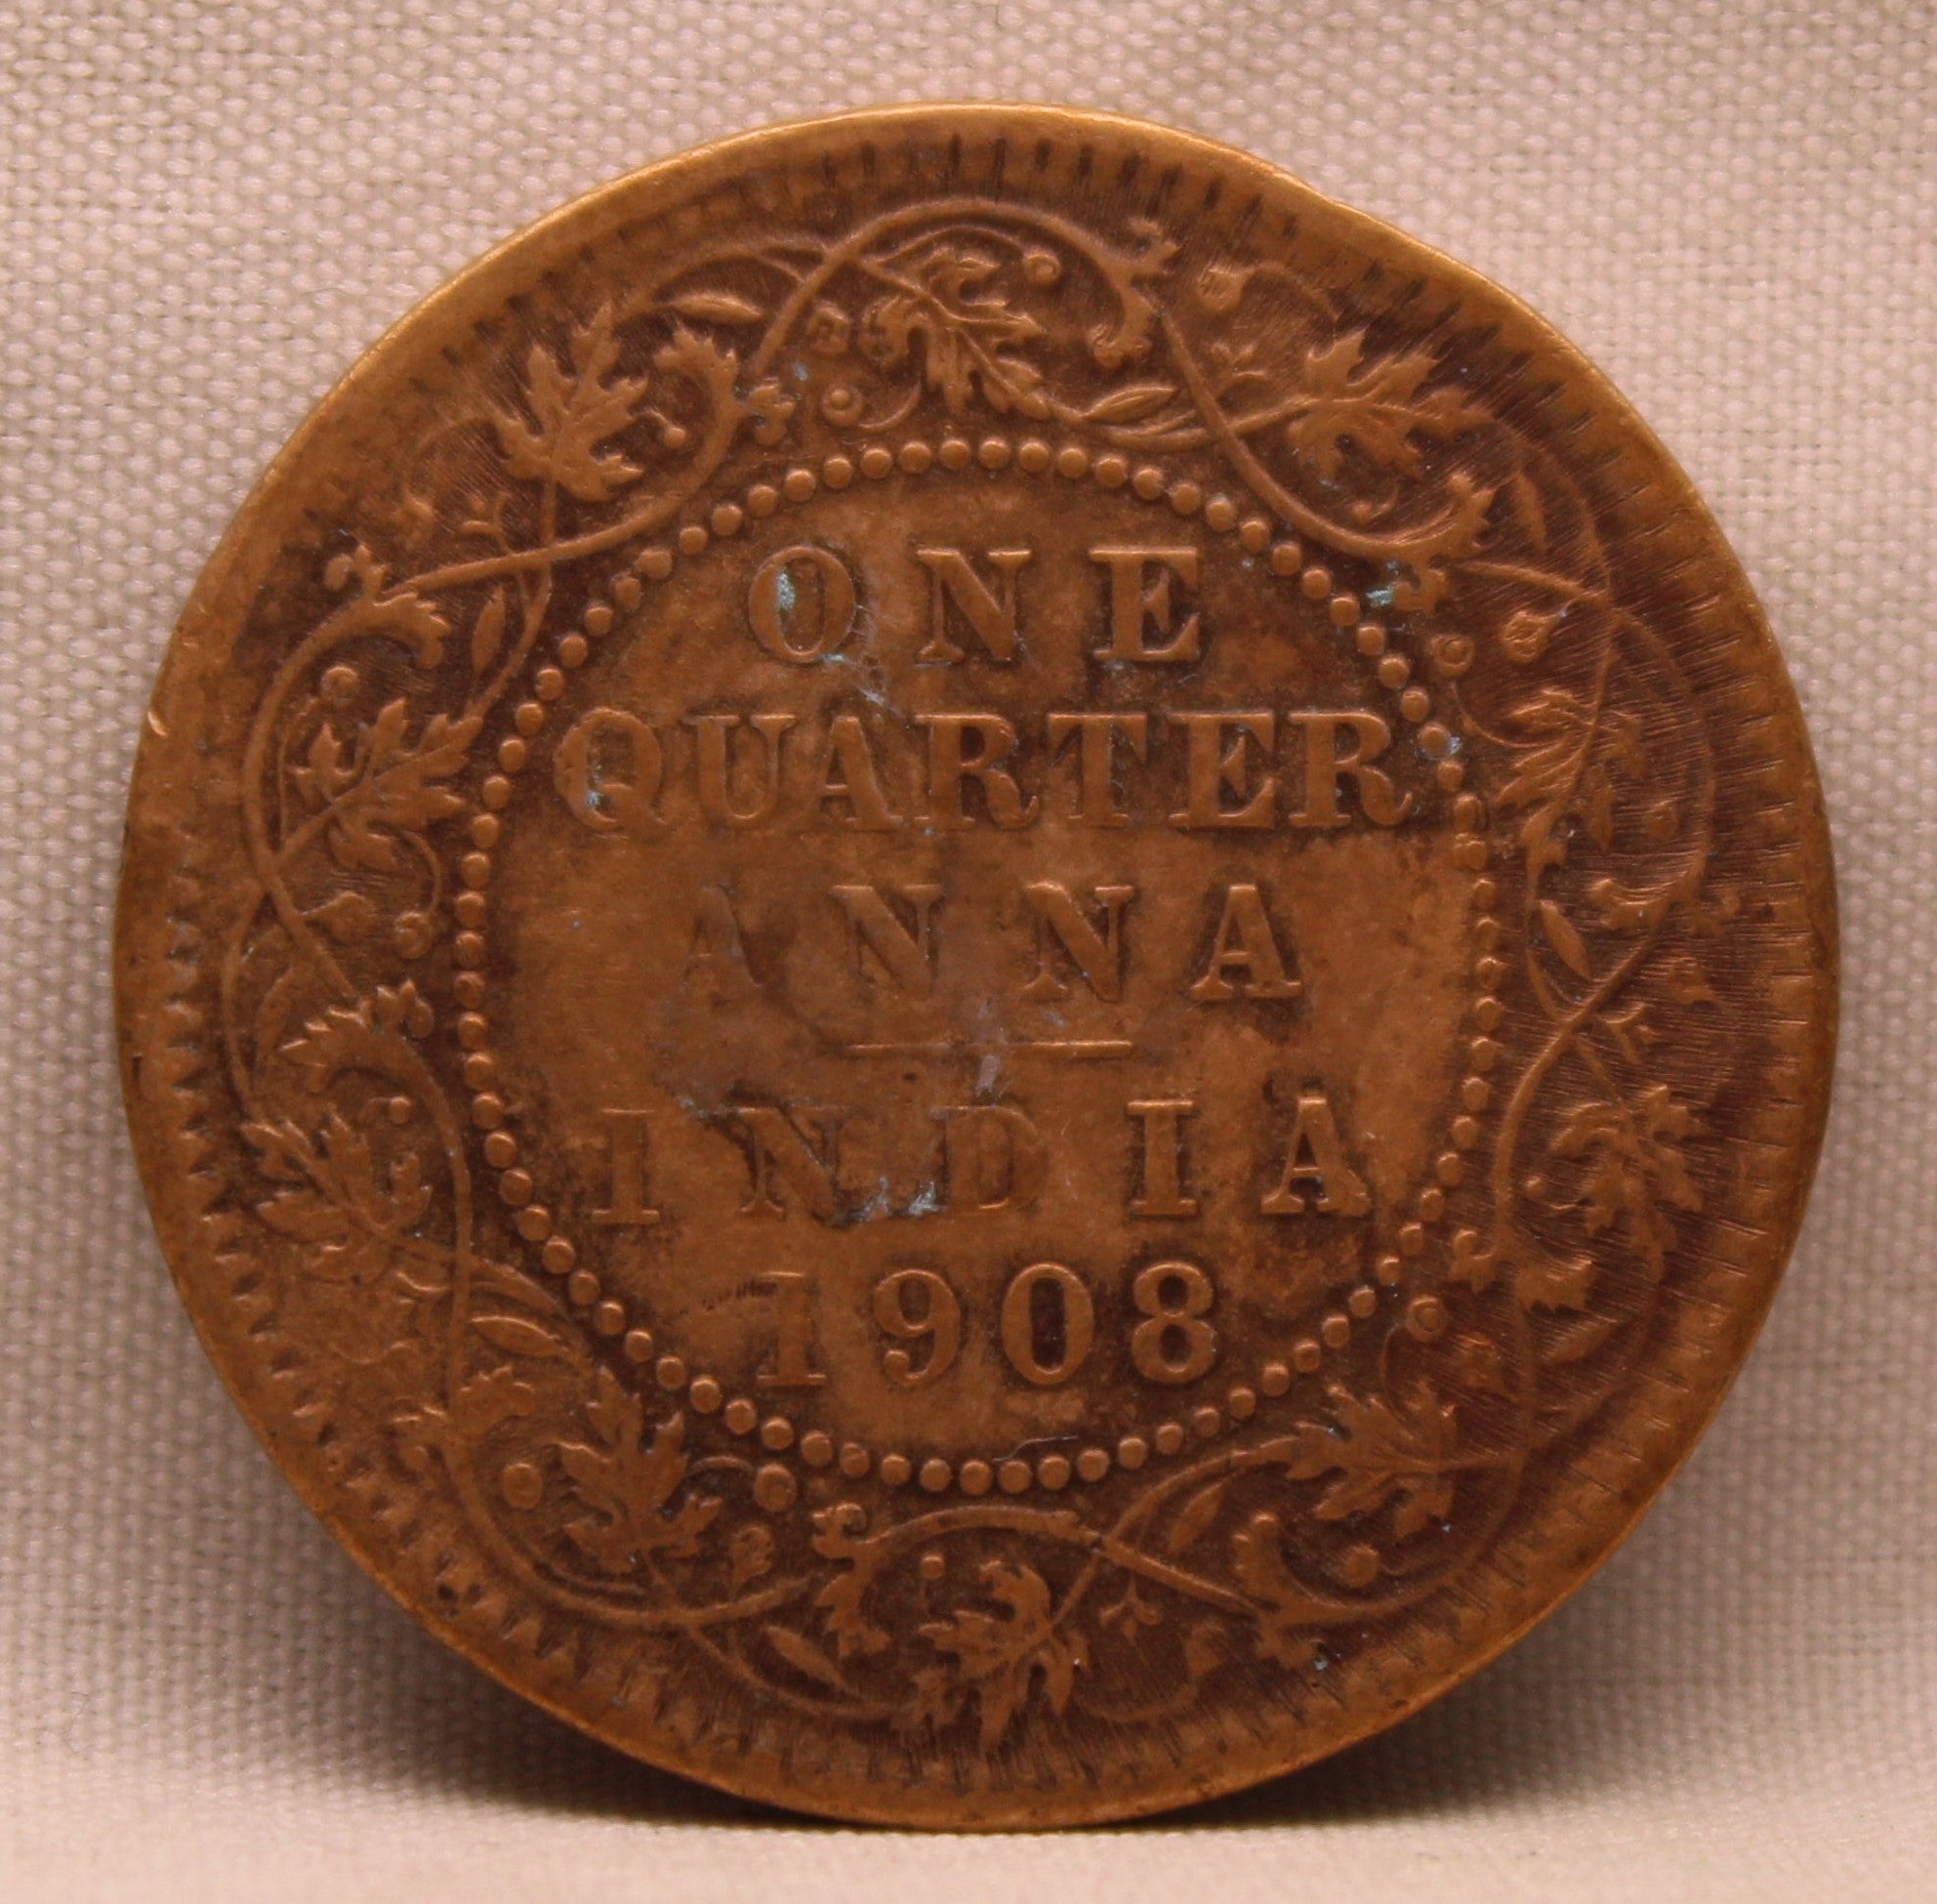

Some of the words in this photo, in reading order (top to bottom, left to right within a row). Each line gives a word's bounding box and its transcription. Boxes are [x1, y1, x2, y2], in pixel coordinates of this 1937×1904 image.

[748, 545, 1201, 666] ONE
[553, 706, 1415, 834] QUARTER
[682, 881, 1304, 1003] ANNA
[591, 1094, 1369, 1225] INDIA
[754, 1260, 1216, 1387] 1908
